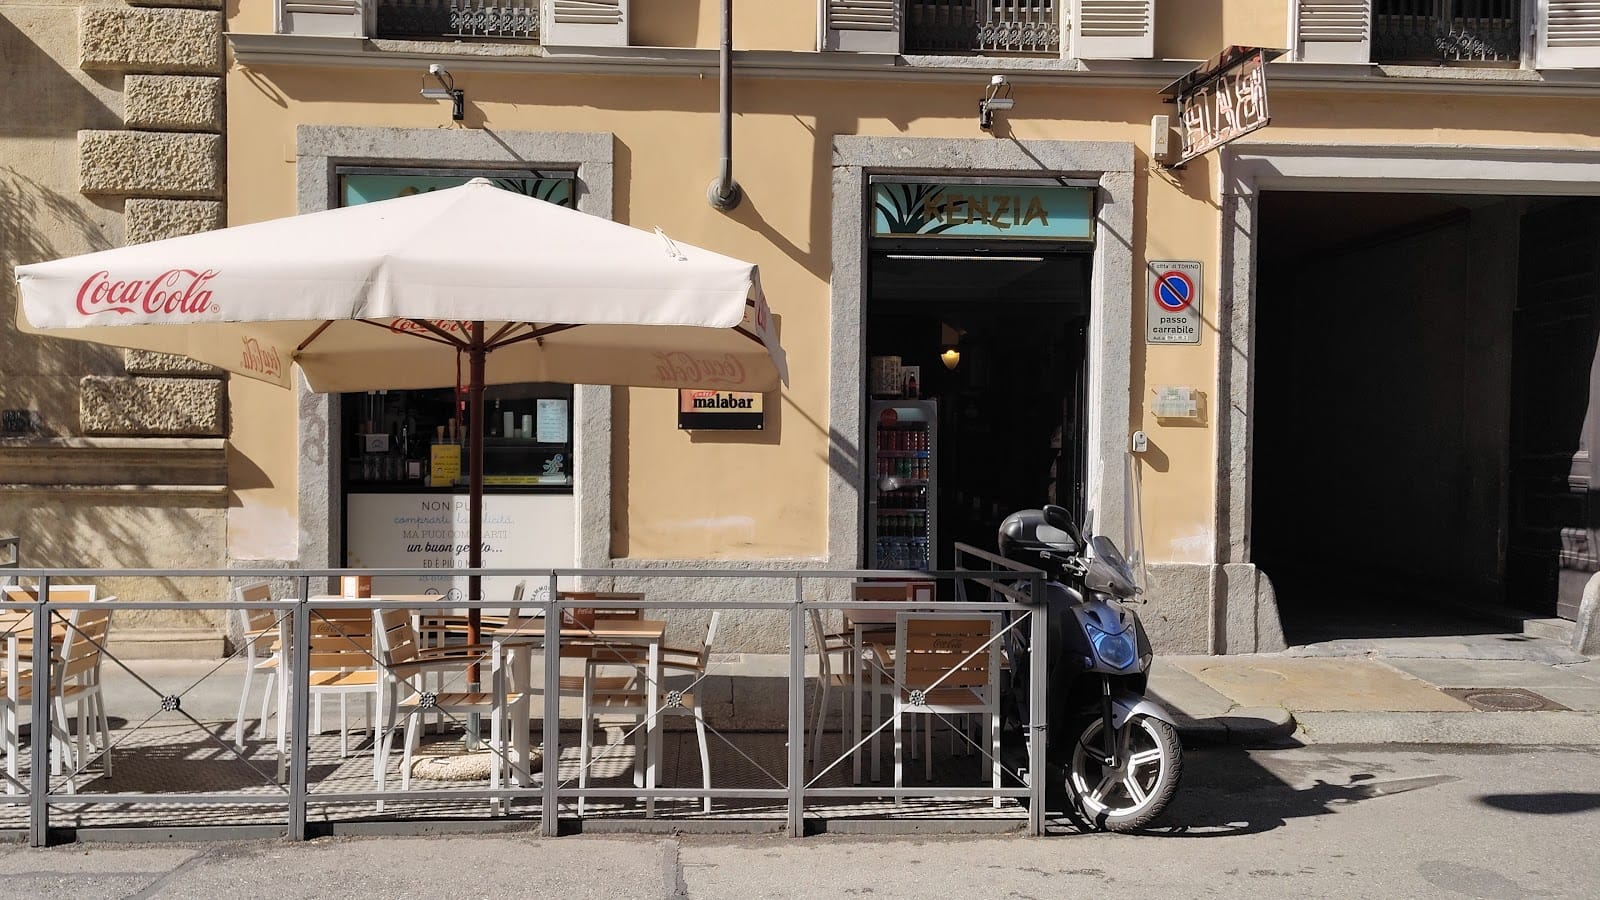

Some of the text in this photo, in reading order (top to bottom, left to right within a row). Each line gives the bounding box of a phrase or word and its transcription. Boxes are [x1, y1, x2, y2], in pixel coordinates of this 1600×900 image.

[923, 191, 1049, 231] KENZIA
[76, 268, 222, 316] Coca-Cola
[1160, 316, 1187, 325] passo
[1152, 325, 1194, 334] carrabile
[693, 392, 753, 409] malabar
[421, 501, 488, 511] NON PUI
[403, 530, 508, 539] MA PUOI COMARTI
[406, 541, 503, 557] un buon geto...
[423, 559, 433, 568] ED
[442, 557, 455, 568] PIÙ
